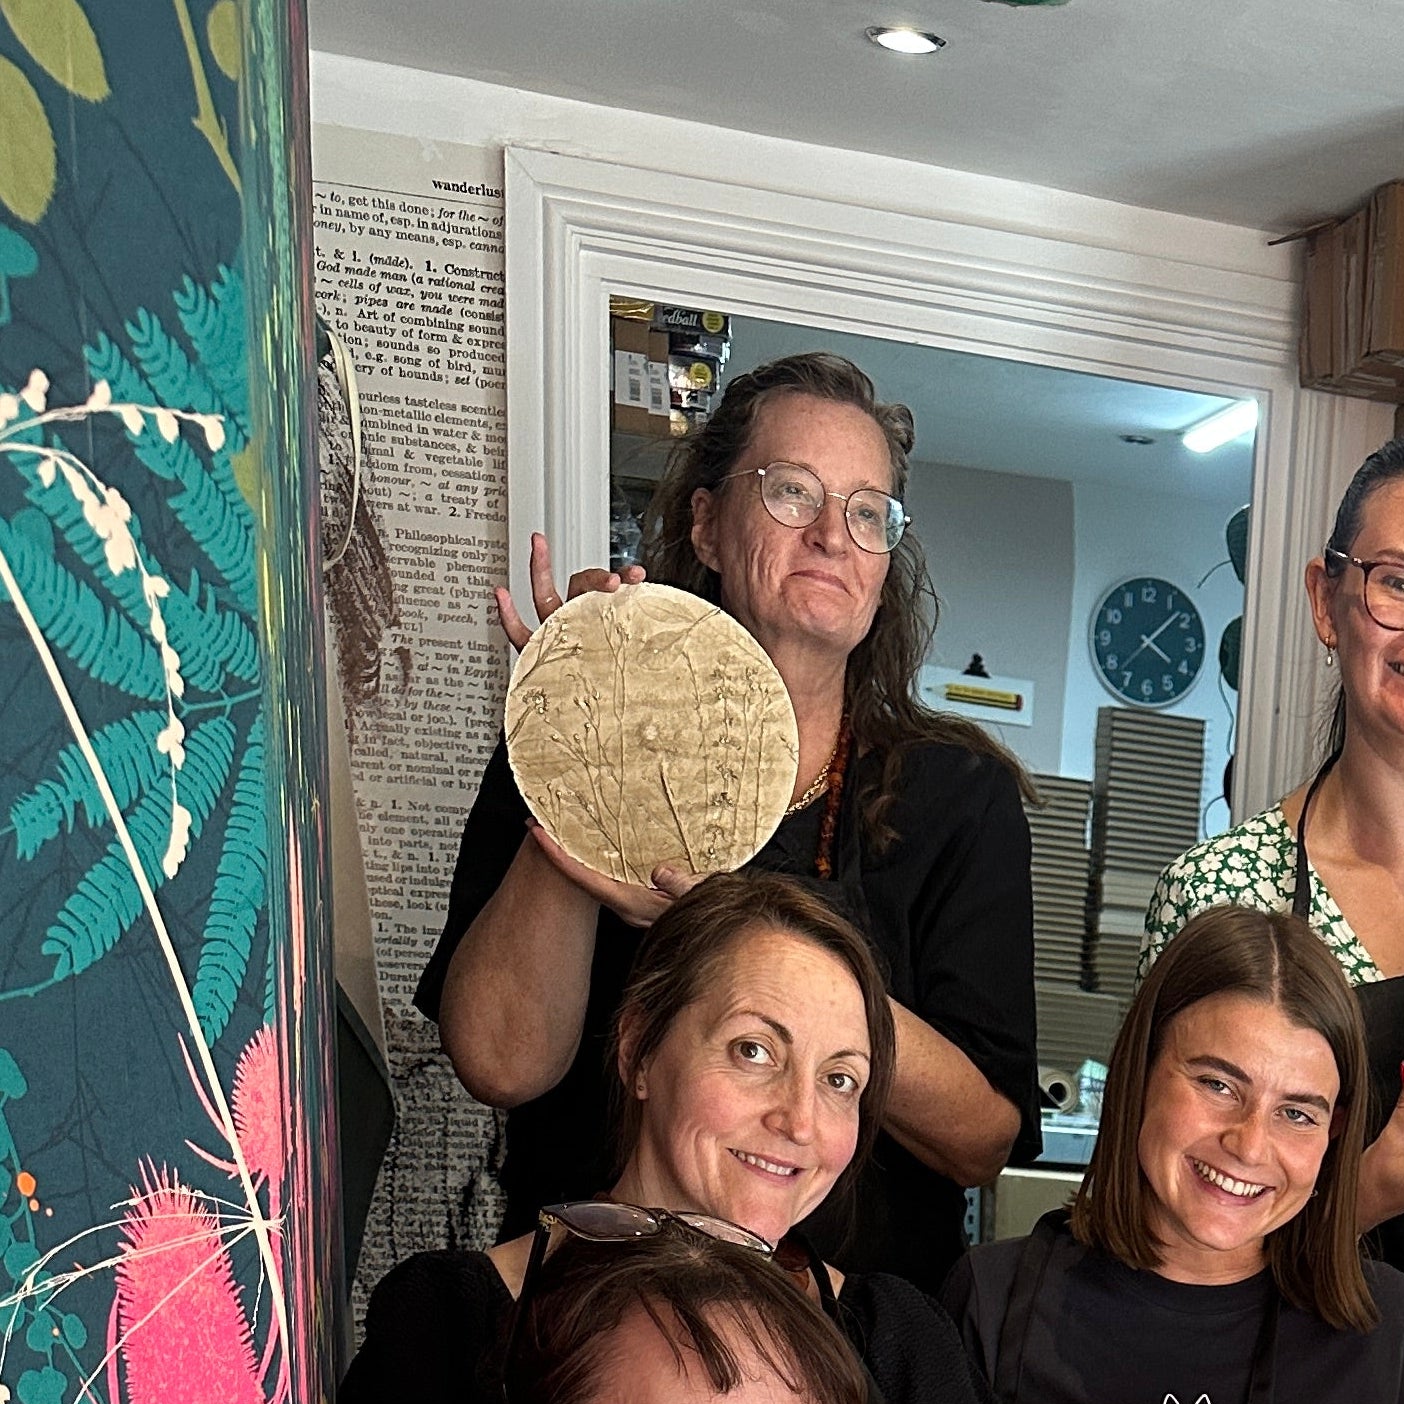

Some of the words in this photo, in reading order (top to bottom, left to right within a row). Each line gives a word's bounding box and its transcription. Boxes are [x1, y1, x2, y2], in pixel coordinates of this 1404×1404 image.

[371, 197, 395, 211] this
[335, 208, 369, 221] name
[390, 216, 414, 229] esp.
[430, 220, 502, 240] adjurations
[368, 227, 392, 241] any
[354, 320, 397, 339] beauty
[418, 328, 447, 343] form
[400, 315, 464, 334] combining
[1123, 592, 1134, 608] 11
[1141, 587, 1157, 603] 12
[1166, 595, 1173, 610] 1
[1106, 609, 1122, 624] 10
[1179, 612, 1191, 629] 2
[1100, 630, 1111, 646] 9
[1185, 637, 1196, 652] 3
[1106, 654, 1118, 670] 8
[1177, 660, 1188, 674] 4
[1121, 671, 1133, 686] 7
[1162, 674, 1174, 691] 5
[1141, 679, 1153, 696] 6
